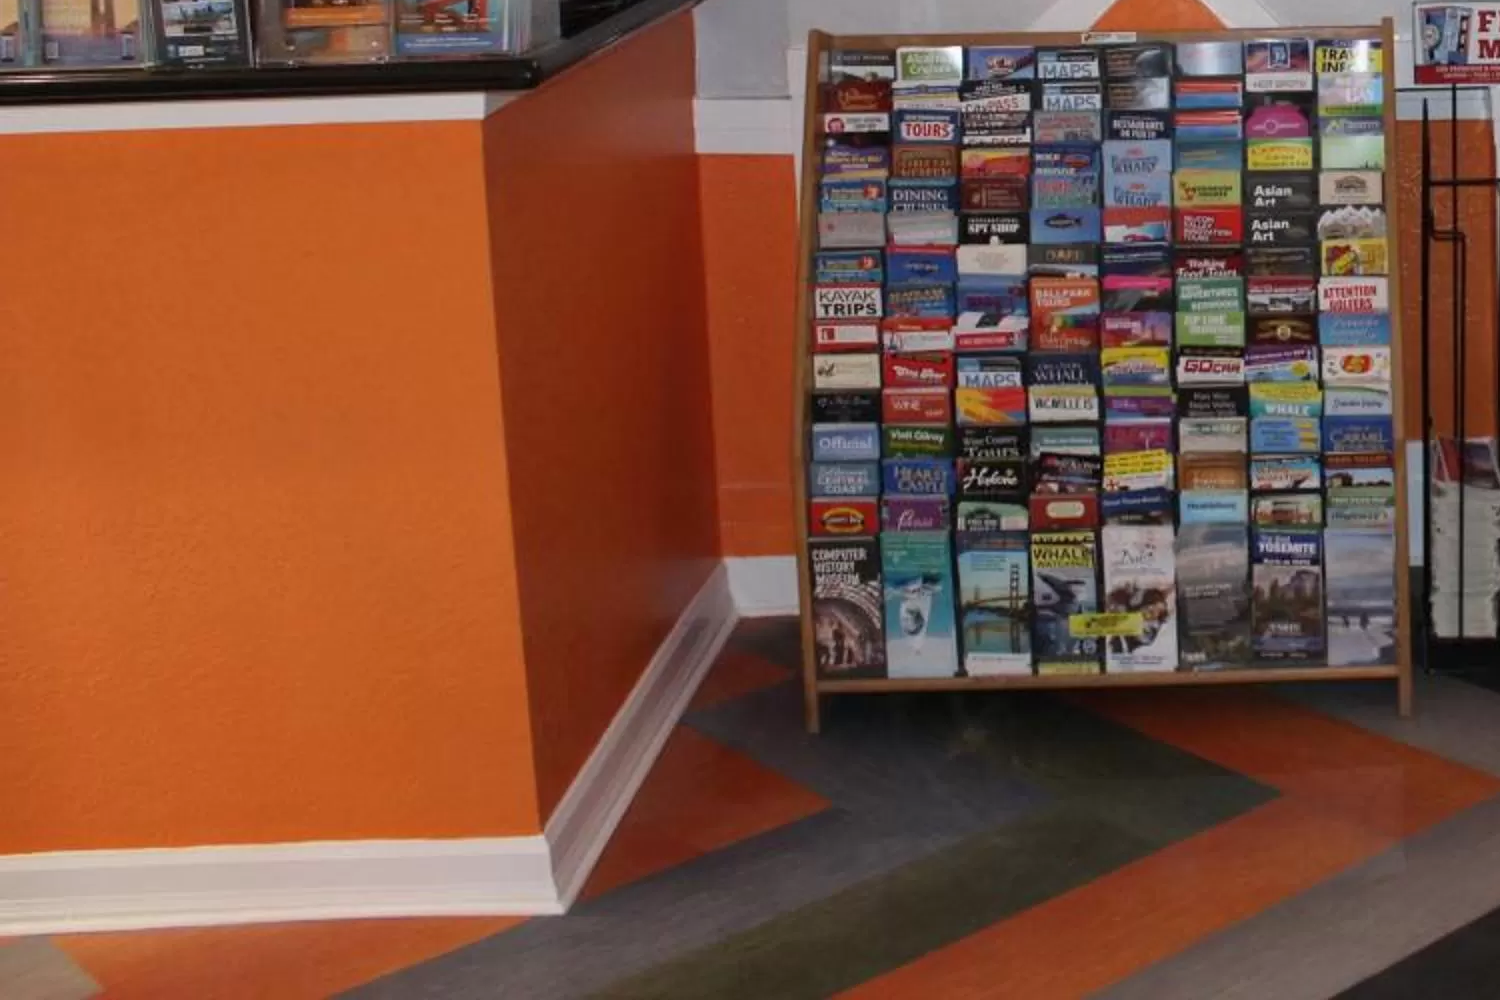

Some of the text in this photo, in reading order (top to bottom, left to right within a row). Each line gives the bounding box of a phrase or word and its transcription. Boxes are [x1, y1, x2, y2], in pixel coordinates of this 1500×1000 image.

[1043, 63, 1093, 78] MAPS
[1046, 96, 1097, 109] MAPS
[905, 123, 950, 138] TOURS
[892, 189, 948, 201] DINING
[1253, 185, 1293, 197] Asian
[1254, 197, 1276, 207] Art
[1251, 219, 1290, 231] Asian
[1252, 231, 1275, 241] Art
[819, 290, 877, 303] KAYAK
[1035, 288, 1091, 298] BALLPARK
[1323, 284, 1377, 298] ATTENTION
[822, 303, 877, 315] TRIPS
[965, 374, 1018, 388] MAPS
[819, 436, 873, 450] Official
[823, 485, 865, 495] COAST
[1033, 546, 1092, 561] WHALE
[1258, 541, 1317, 554] YOSEMITE
[812, 548, 867, 561] COMPUTER
